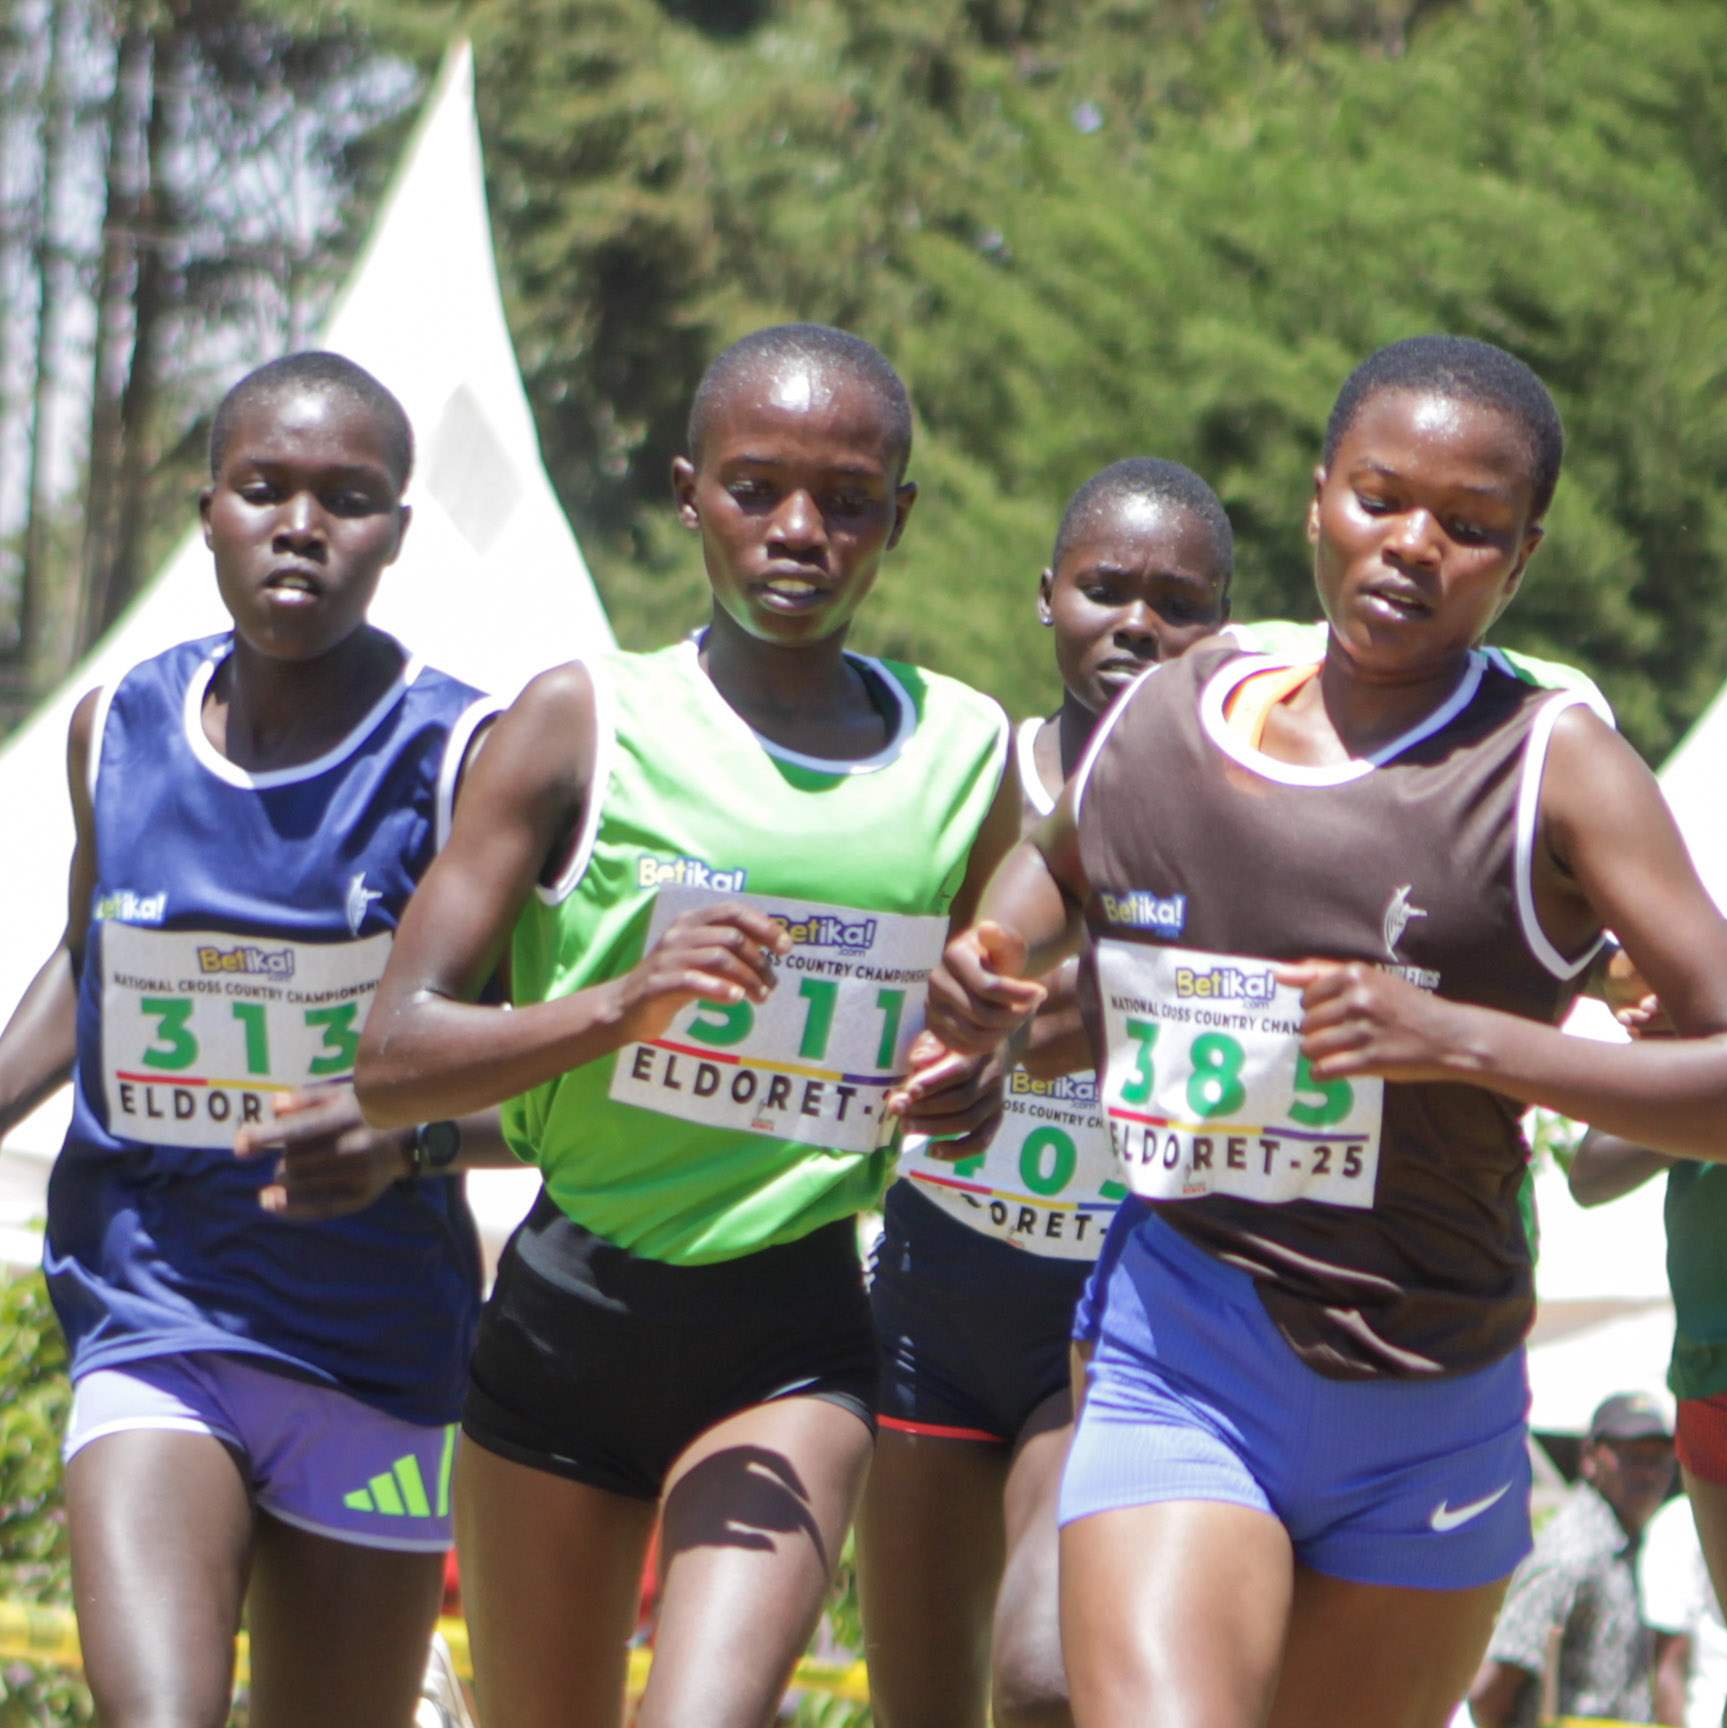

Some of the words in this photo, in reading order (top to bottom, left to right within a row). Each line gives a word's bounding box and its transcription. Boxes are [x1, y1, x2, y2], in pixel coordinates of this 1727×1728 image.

[197, 946, 295, 977] Betika!
[786, 955, 853, 978] COUNTRY
[178, 979, 221, 994] CROSS
[225, 981, 284, 1000] COUNTRY
[1175, 967, 1276, 1001] Betika!
[140, 997, 360, 1075] 313
[1194, 1010, 1257, 1031] COUNTRY
[1120, 1017, 1354, 1127] 385
[1028, 1103, 1084, 1126] COUNTRY
[1109, 1120, 1364, 1178] ELDORET-25
